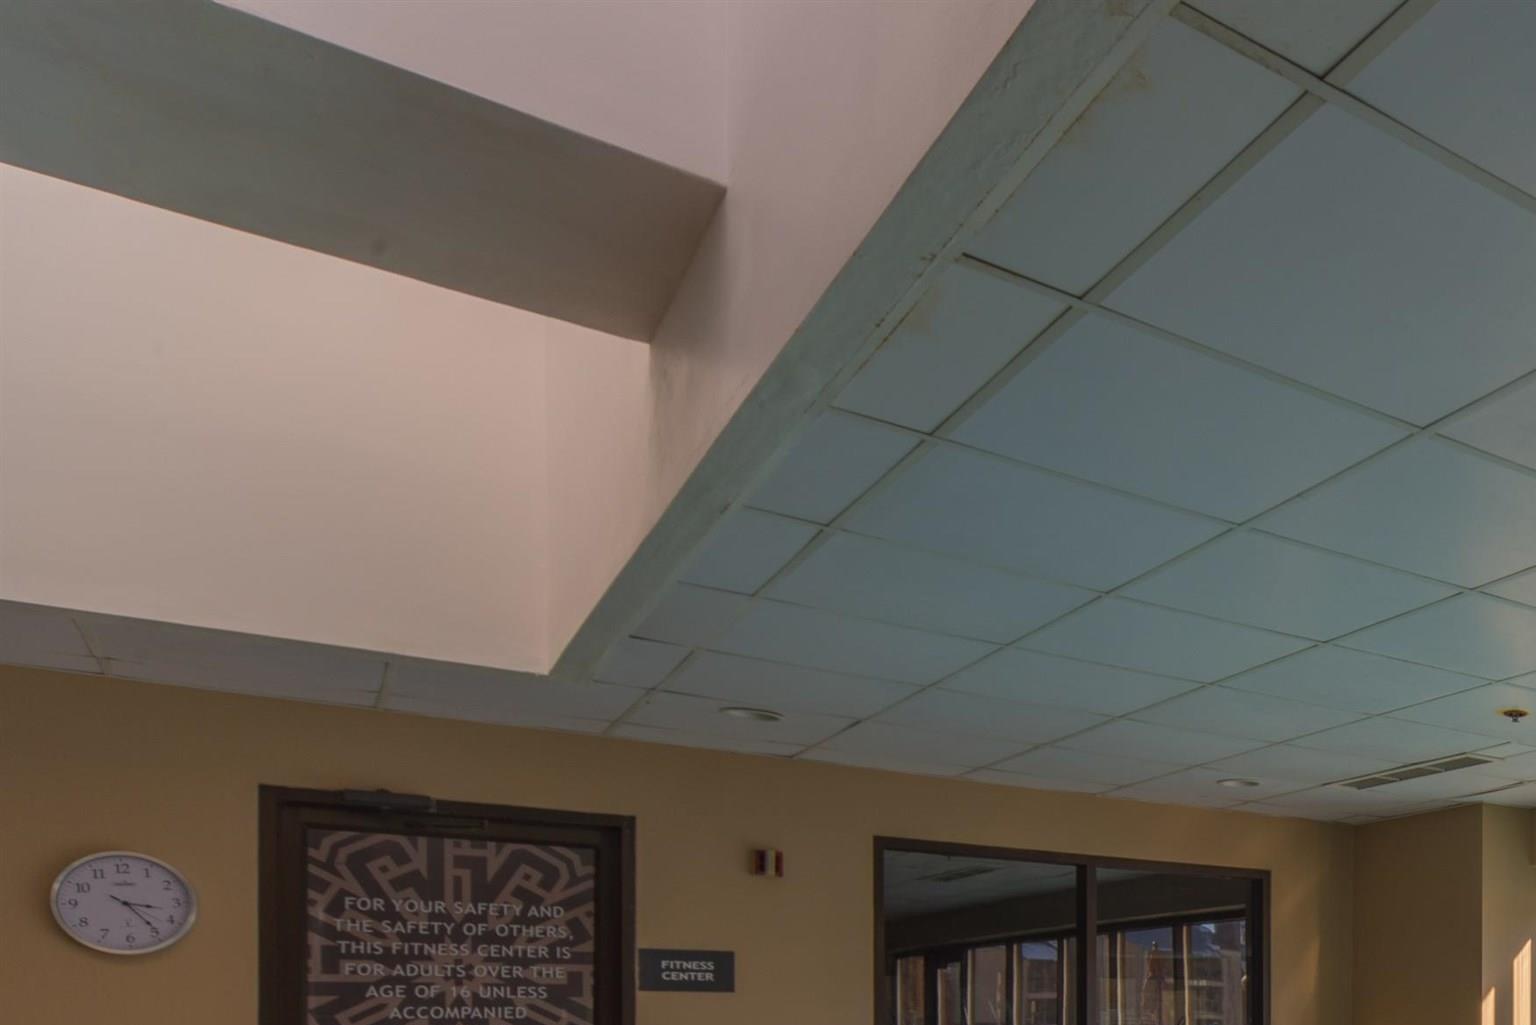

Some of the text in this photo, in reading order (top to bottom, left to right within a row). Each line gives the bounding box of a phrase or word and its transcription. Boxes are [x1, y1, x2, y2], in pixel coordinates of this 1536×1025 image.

[92, 868, 104, 879] 11
[114, 863, 130, 874] 12
[75, 882, 90, 893] 10
[162, 880, 172, 891] 2
[68, 899, 78, 909] 9
[172, 898, 181, 908] 3
[344, 896, 565, 918] FOR YOUR SAFETY AND
[79, 917, 89, 927] 8
[167, 915, 175, 925] 4
[151, 927, 160, 938] 5
[335, 919, 374, 933] THE
[382, 920, 455, 935] SAFETY
[463, 922, 489, 936] OF
[99, 928, 110, 939] 7
[126, 934, 136, 944] 6
[336, 940, 571, 959] THIS FITNESS CENTER IS
[344, 962, 566, 979] FOR ADULTS OVER THE
[661, 960, 715, 970] FITNESS
[661, 971, 715, 981] CENTER
[365, 985, 548, 999] AGE OF 16 UNLESS
[389, 1006, 528, 1019] ACCOMPANIED
